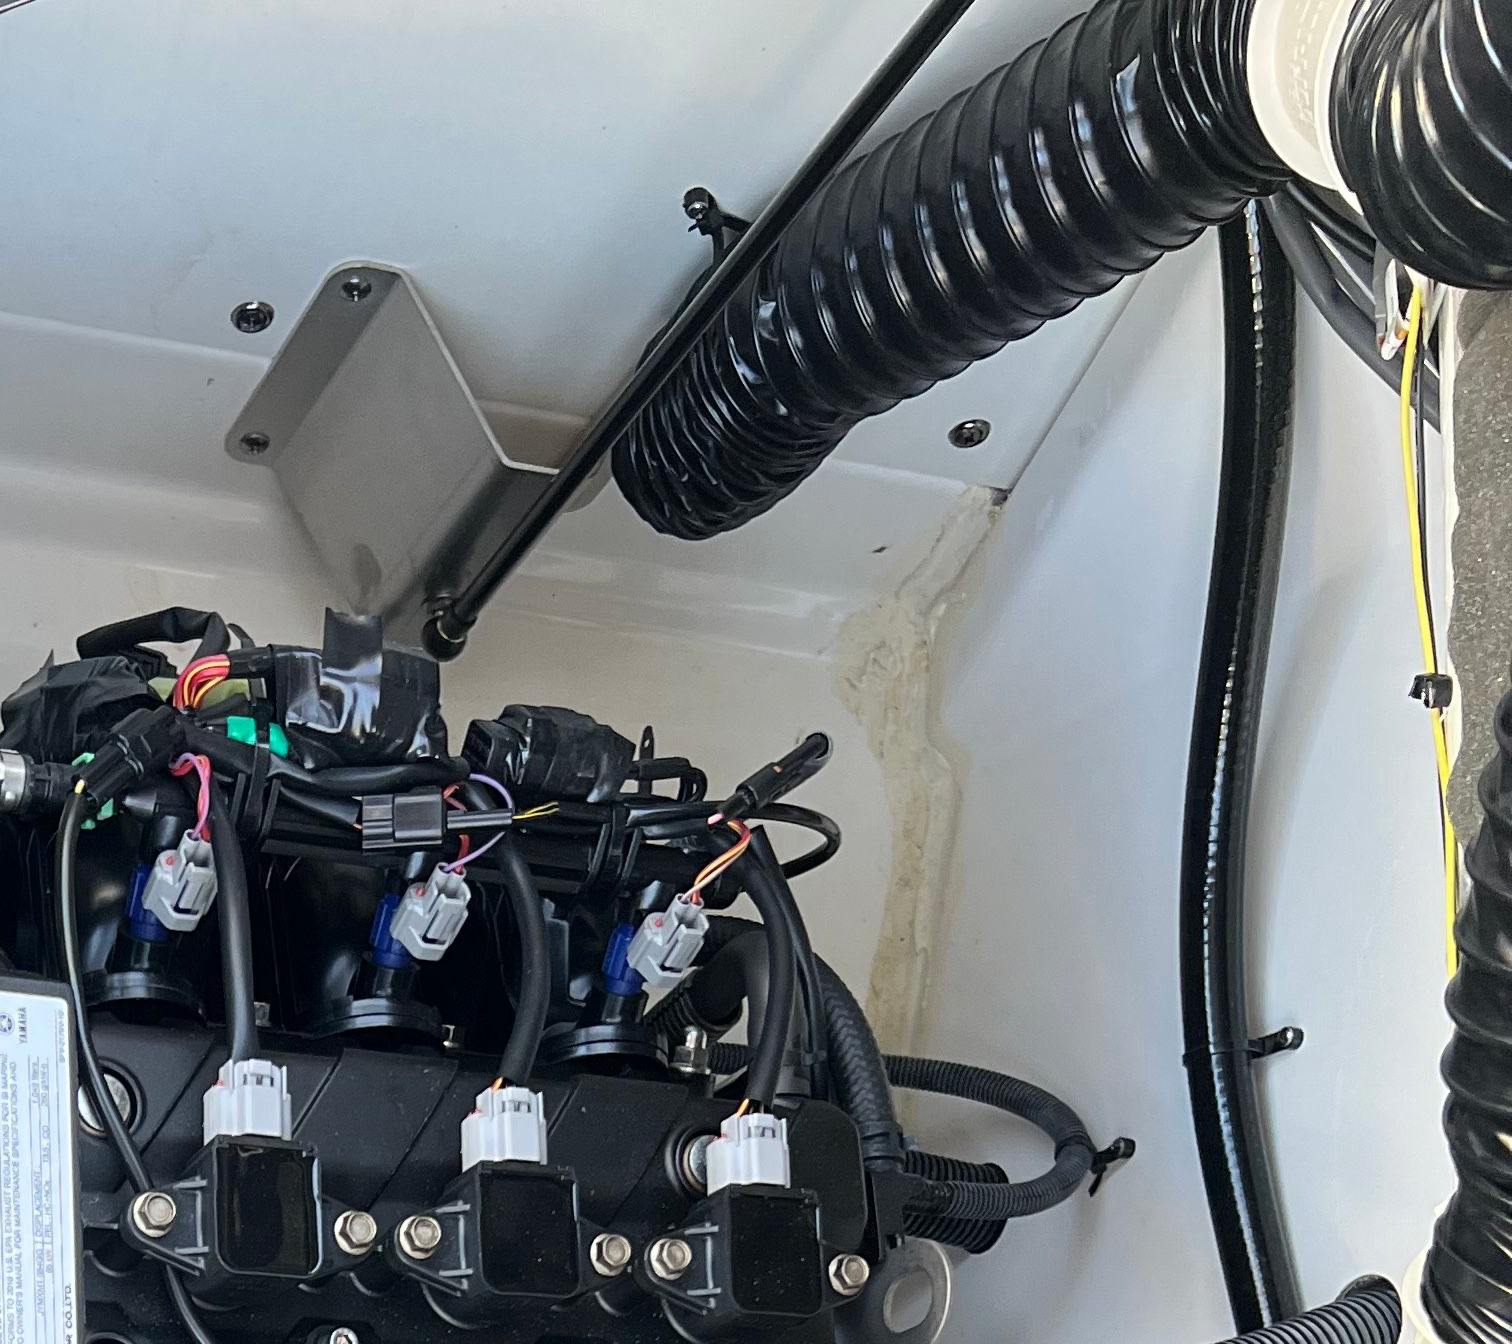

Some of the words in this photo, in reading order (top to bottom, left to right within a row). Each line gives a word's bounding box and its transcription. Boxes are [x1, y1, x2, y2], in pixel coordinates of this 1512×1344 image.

[17, 1007, 27, 1044] YAMAHA
[9, 1061, 17, 1080] AND
[1, 1102, 9, 1121] FOR
[10, 1083, 19, 1157] SPECIFICATIONS
[2, 1124, 10, 1188] REGULATIONS
[3, 1191, 11, 1233] EXHAUST
[12, 1161, 20, 1226] MAINTENANCE
[4, 1235, 12, 1253] EPA
[14, 1251, 22, 1289] MANUAL
[6, 1298, 13, 1309] TO
